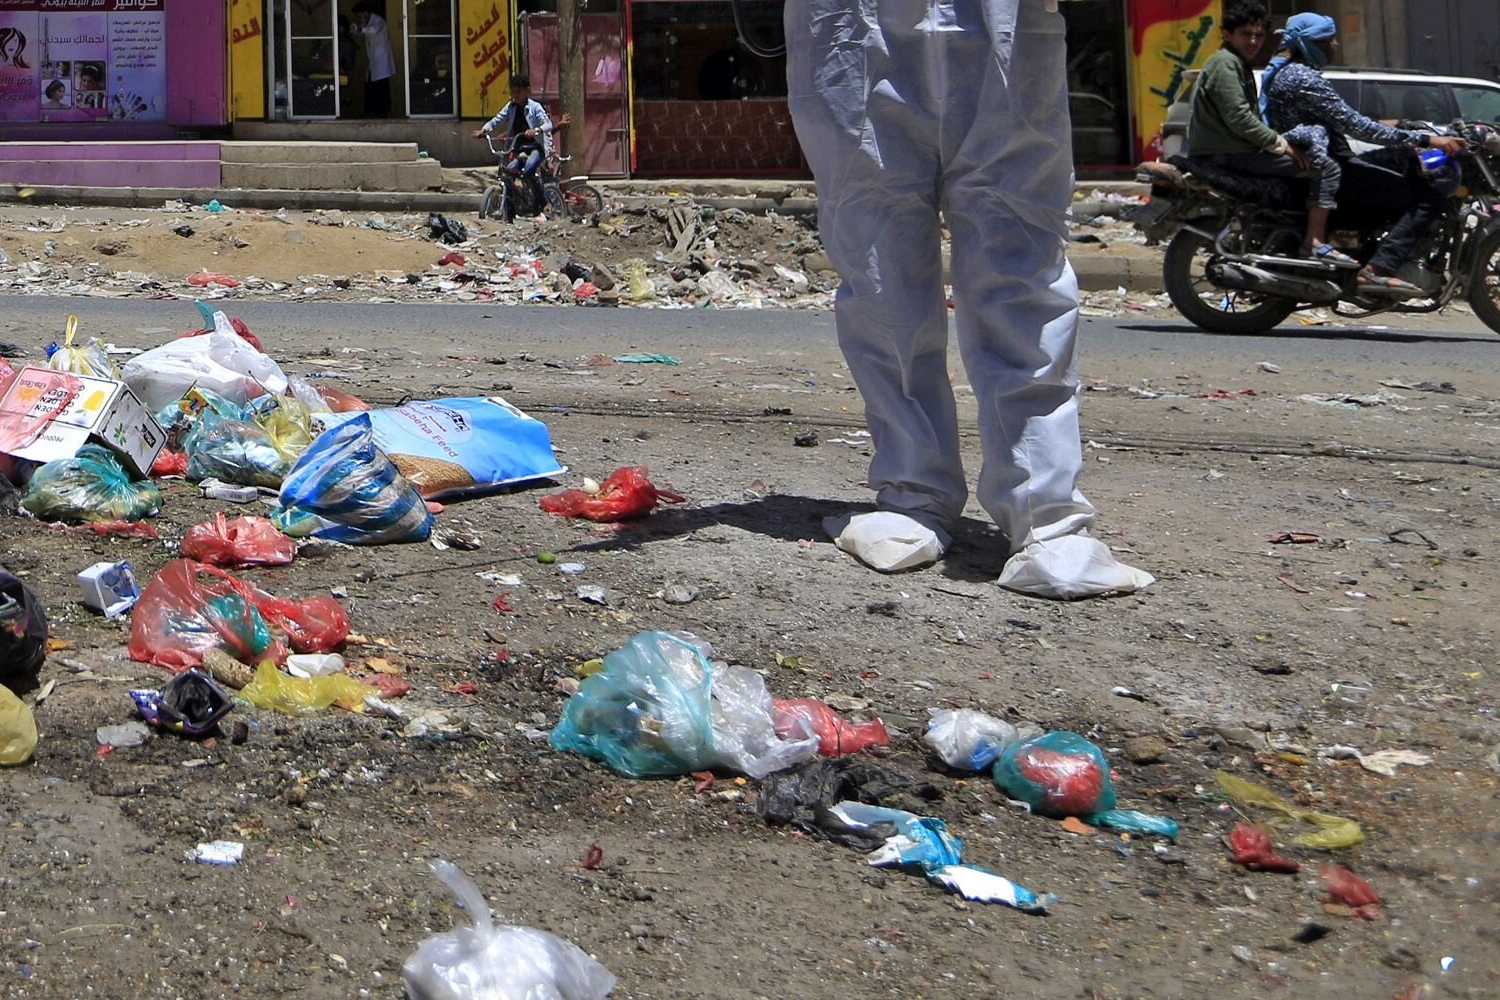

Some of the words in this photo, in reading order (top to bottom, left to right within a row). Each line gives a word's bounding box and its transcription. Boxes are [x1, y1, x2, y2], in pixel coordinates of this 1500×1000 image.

[73, 34, 105, 44] لجمالك
[473, 29, 507, 69] قصات
[432, 434, 459, 458] Feed
